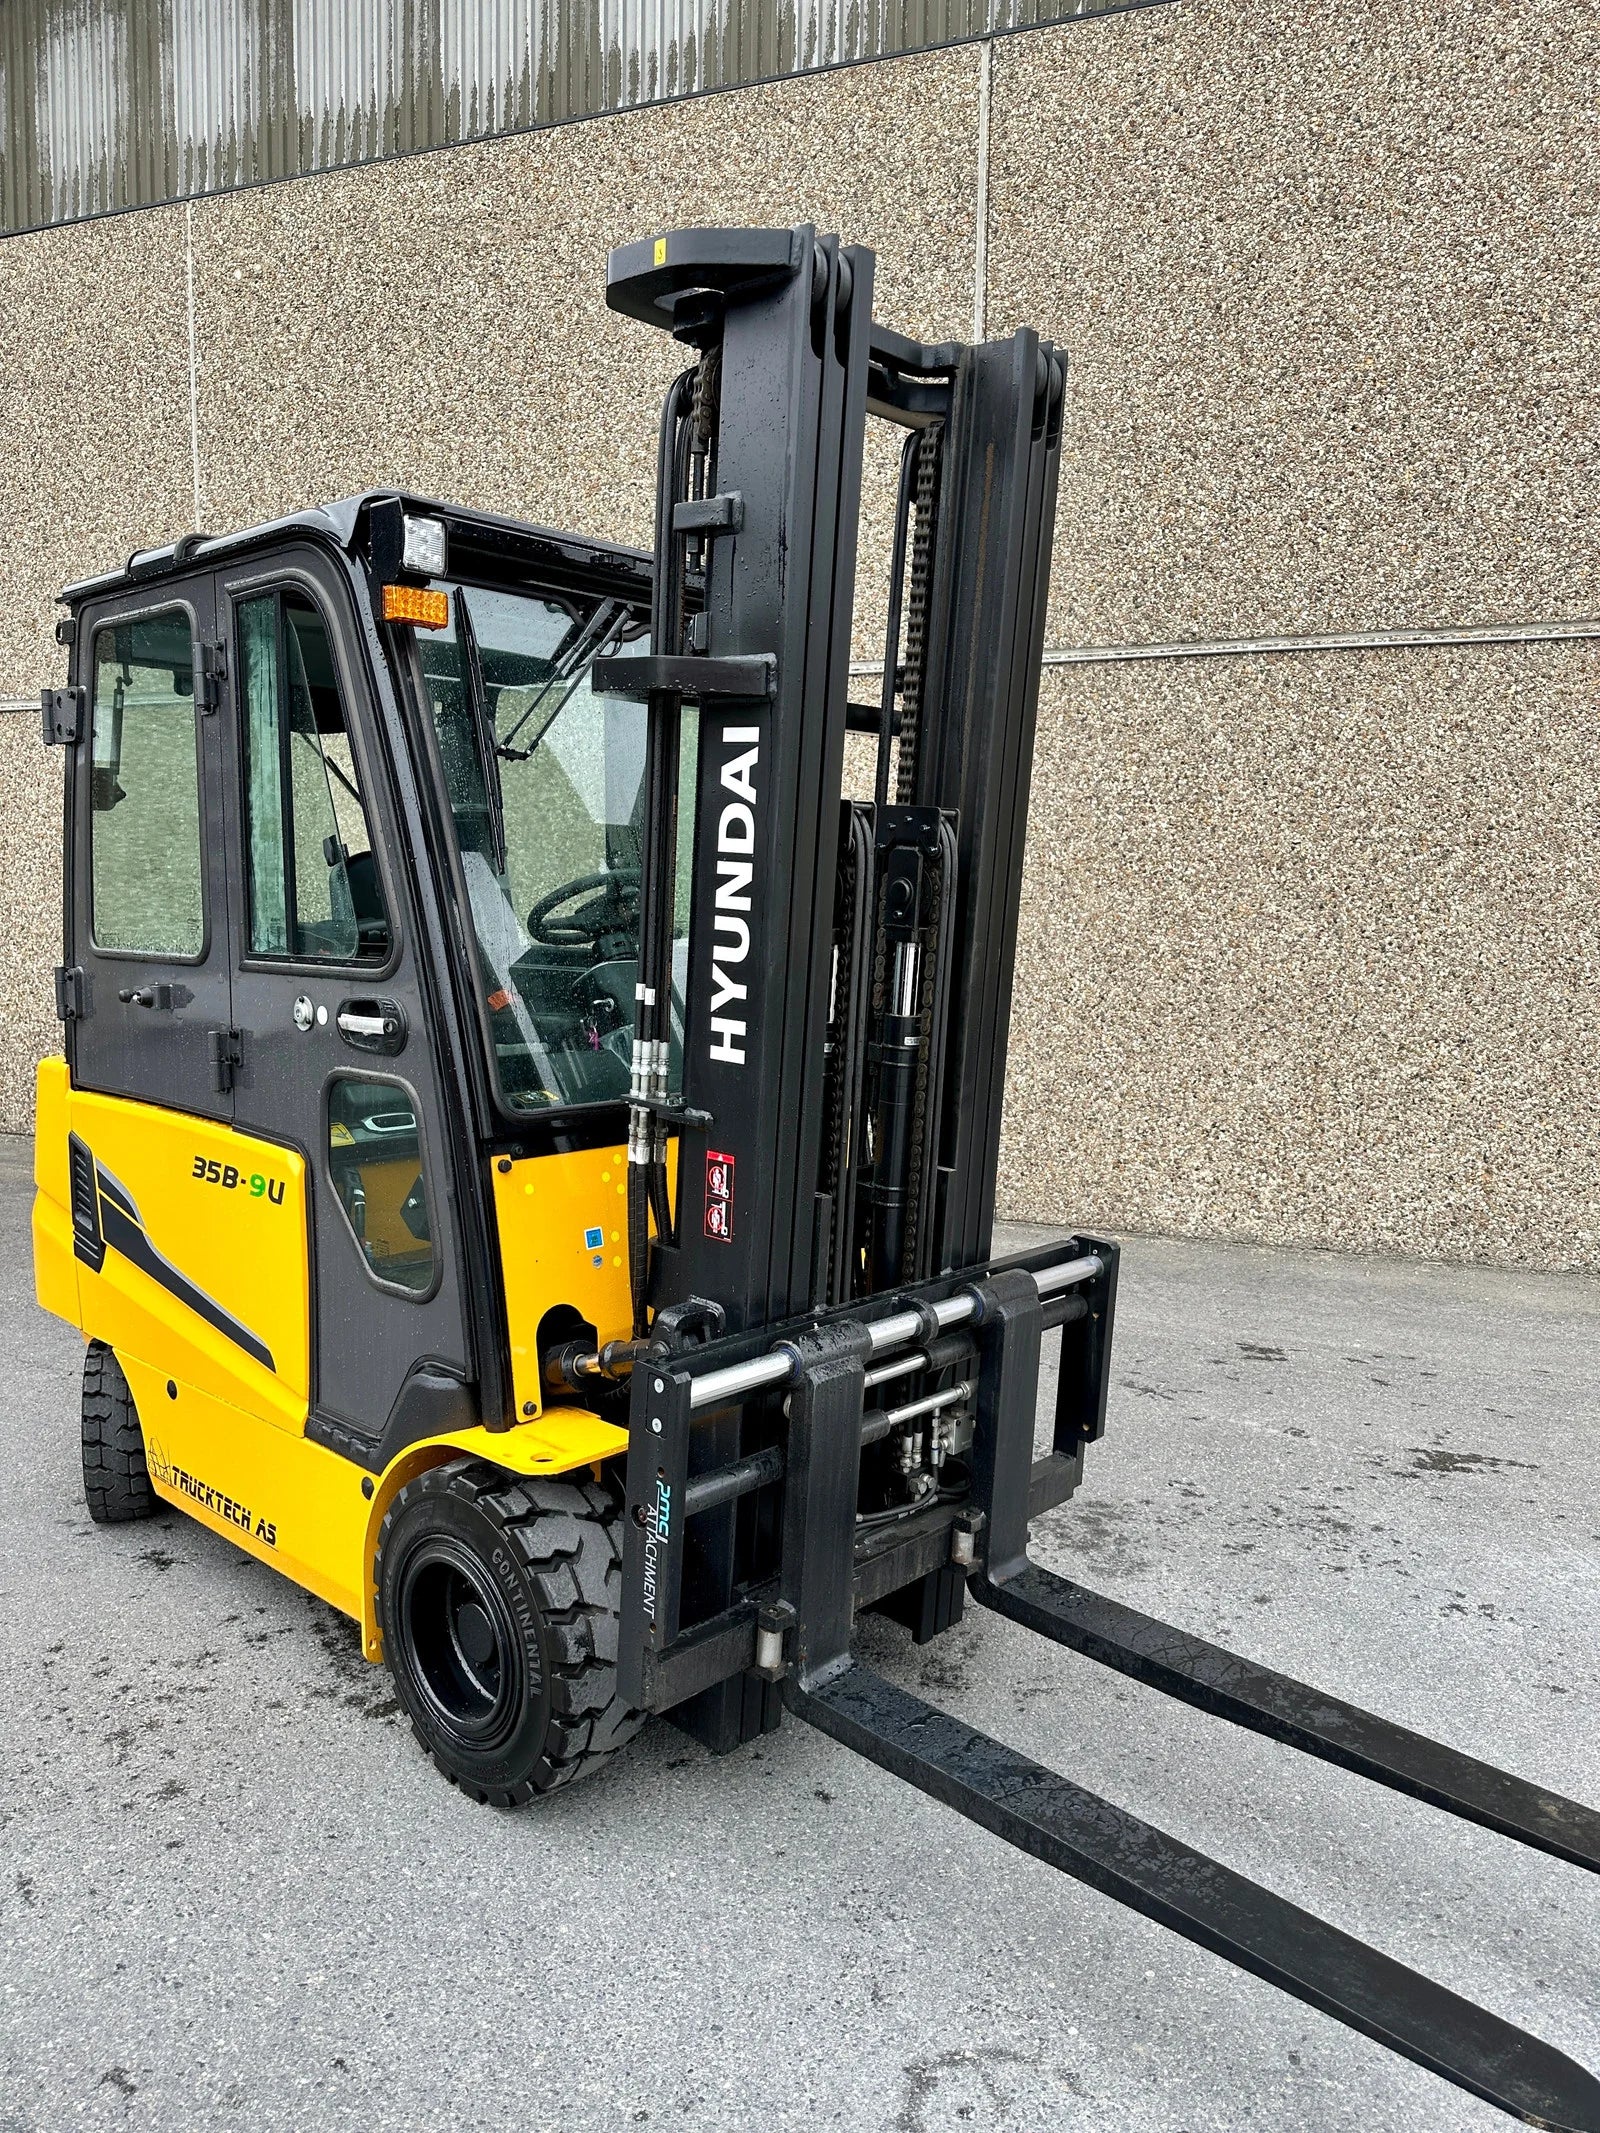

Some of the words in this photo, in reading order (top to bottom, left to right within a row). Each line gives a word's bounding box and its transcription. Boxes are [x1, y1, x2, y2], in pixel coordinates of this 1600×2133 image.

[709, 726, 760, 1065] HYUNDAI
[171, 1465, 252, 1531] TRUCKTECH
[255, 1517, 277, 1546] AS
[642, 1503, 658, 1620] ATTACHMENT
[491, 1547, 543, 1699] CONTINENTAL
